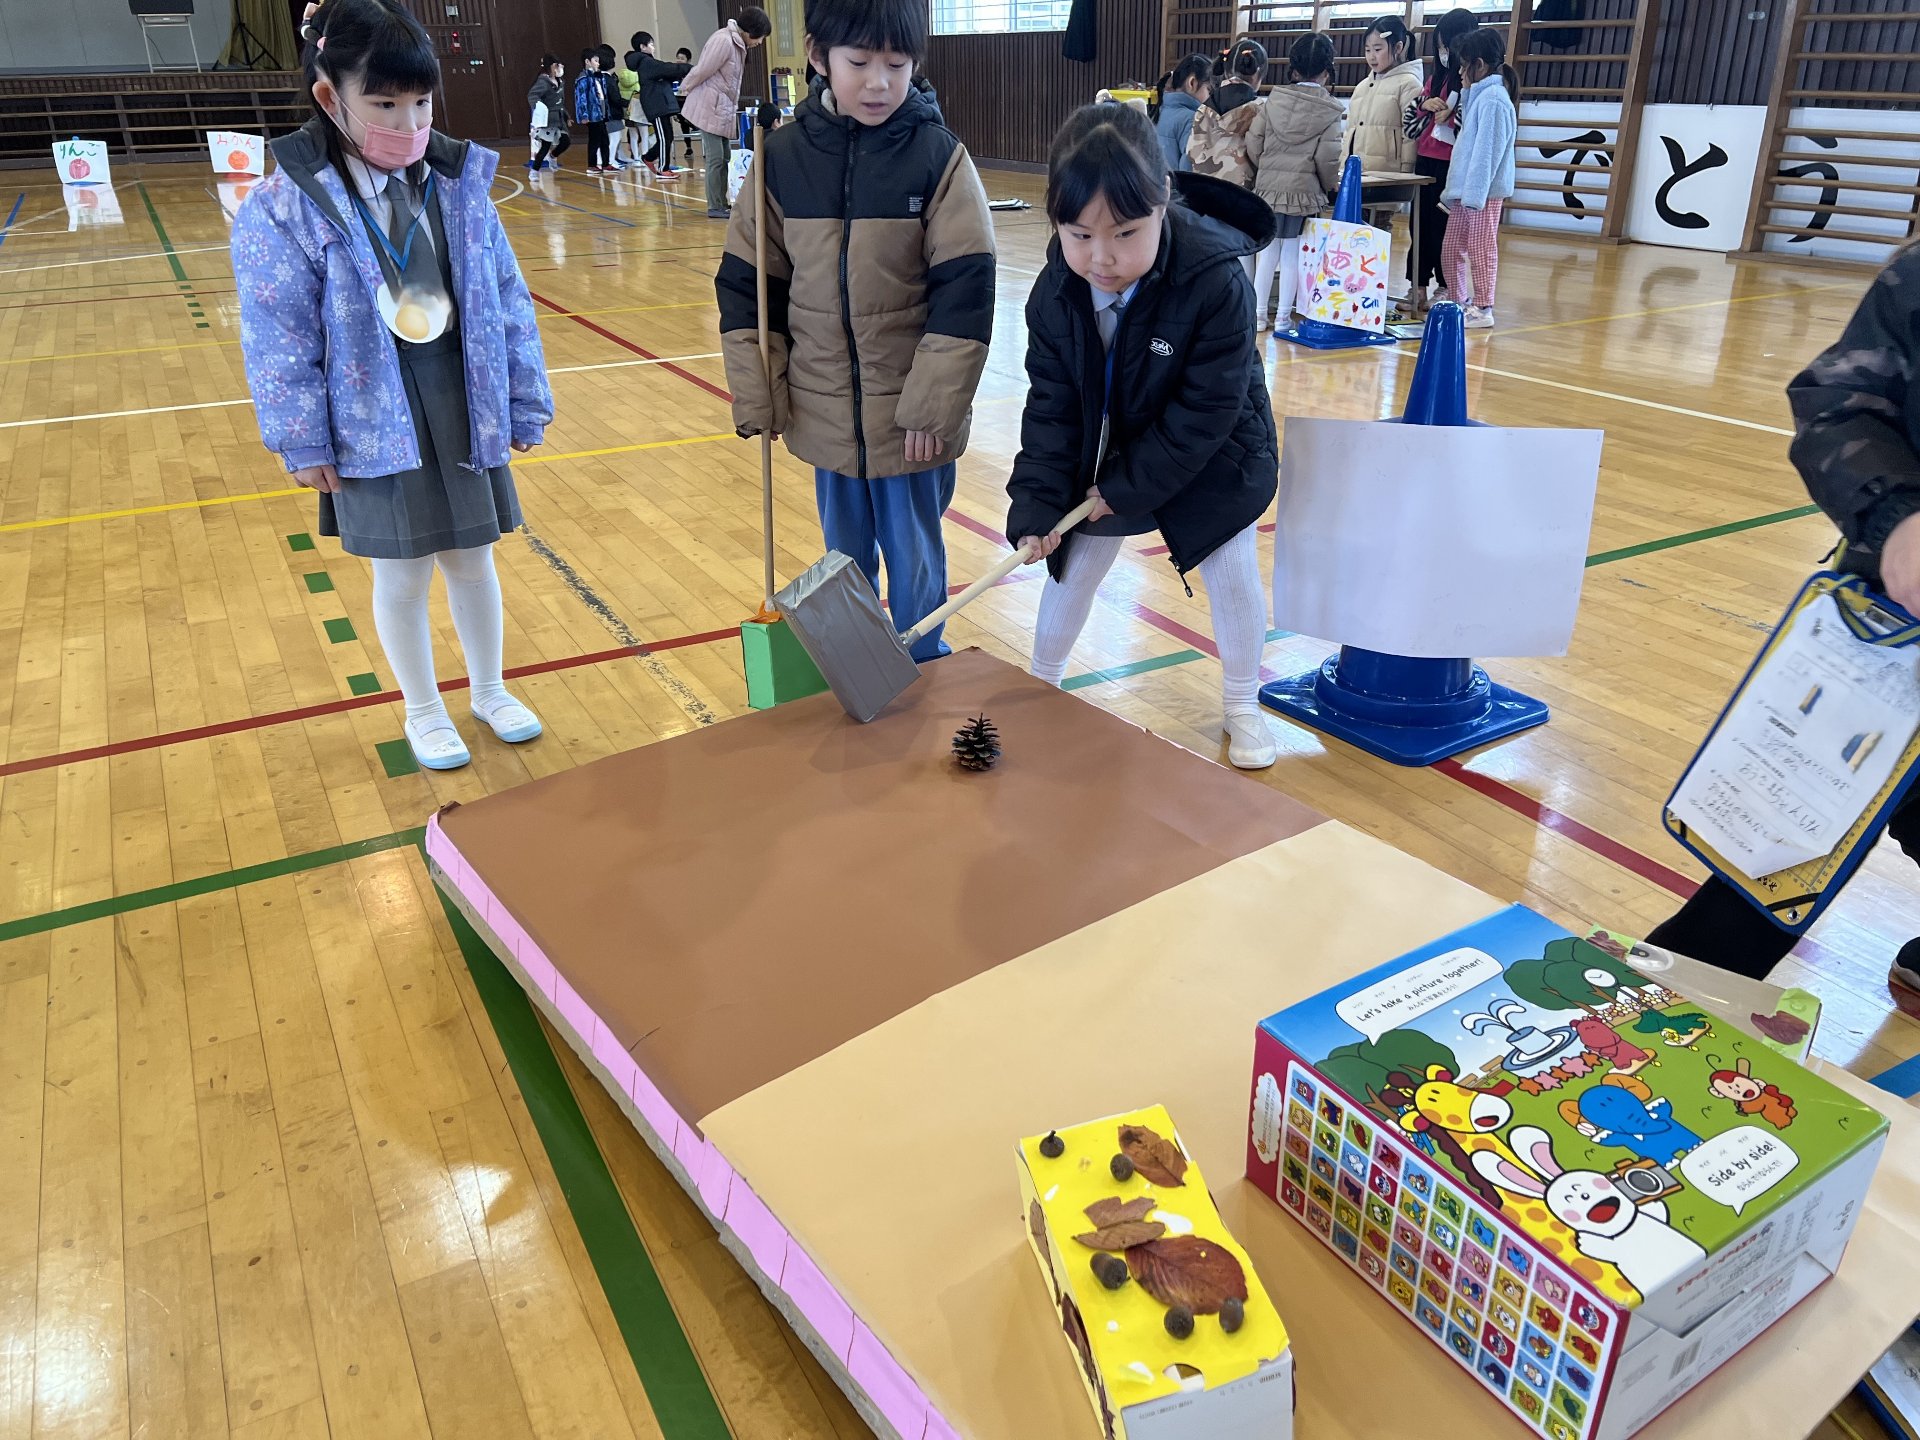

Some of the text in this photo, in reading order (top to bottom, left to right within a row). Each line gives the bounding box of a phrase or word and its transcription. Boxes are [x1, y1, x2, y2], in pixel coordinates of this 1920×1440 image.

[59, 142, 100, 159] りんご
[217, 135, 256, 150] みかん
[1655, 135, 1729, 229] と
[1356, 1007, 1382, 1022] Let's
[1381, 998, 1403, 1010] take
[1412, 978, 1444, 996] picture
[1443, 958, 1486, 980] together!
[1707, 1140, 1777, 1187] Side by side!
